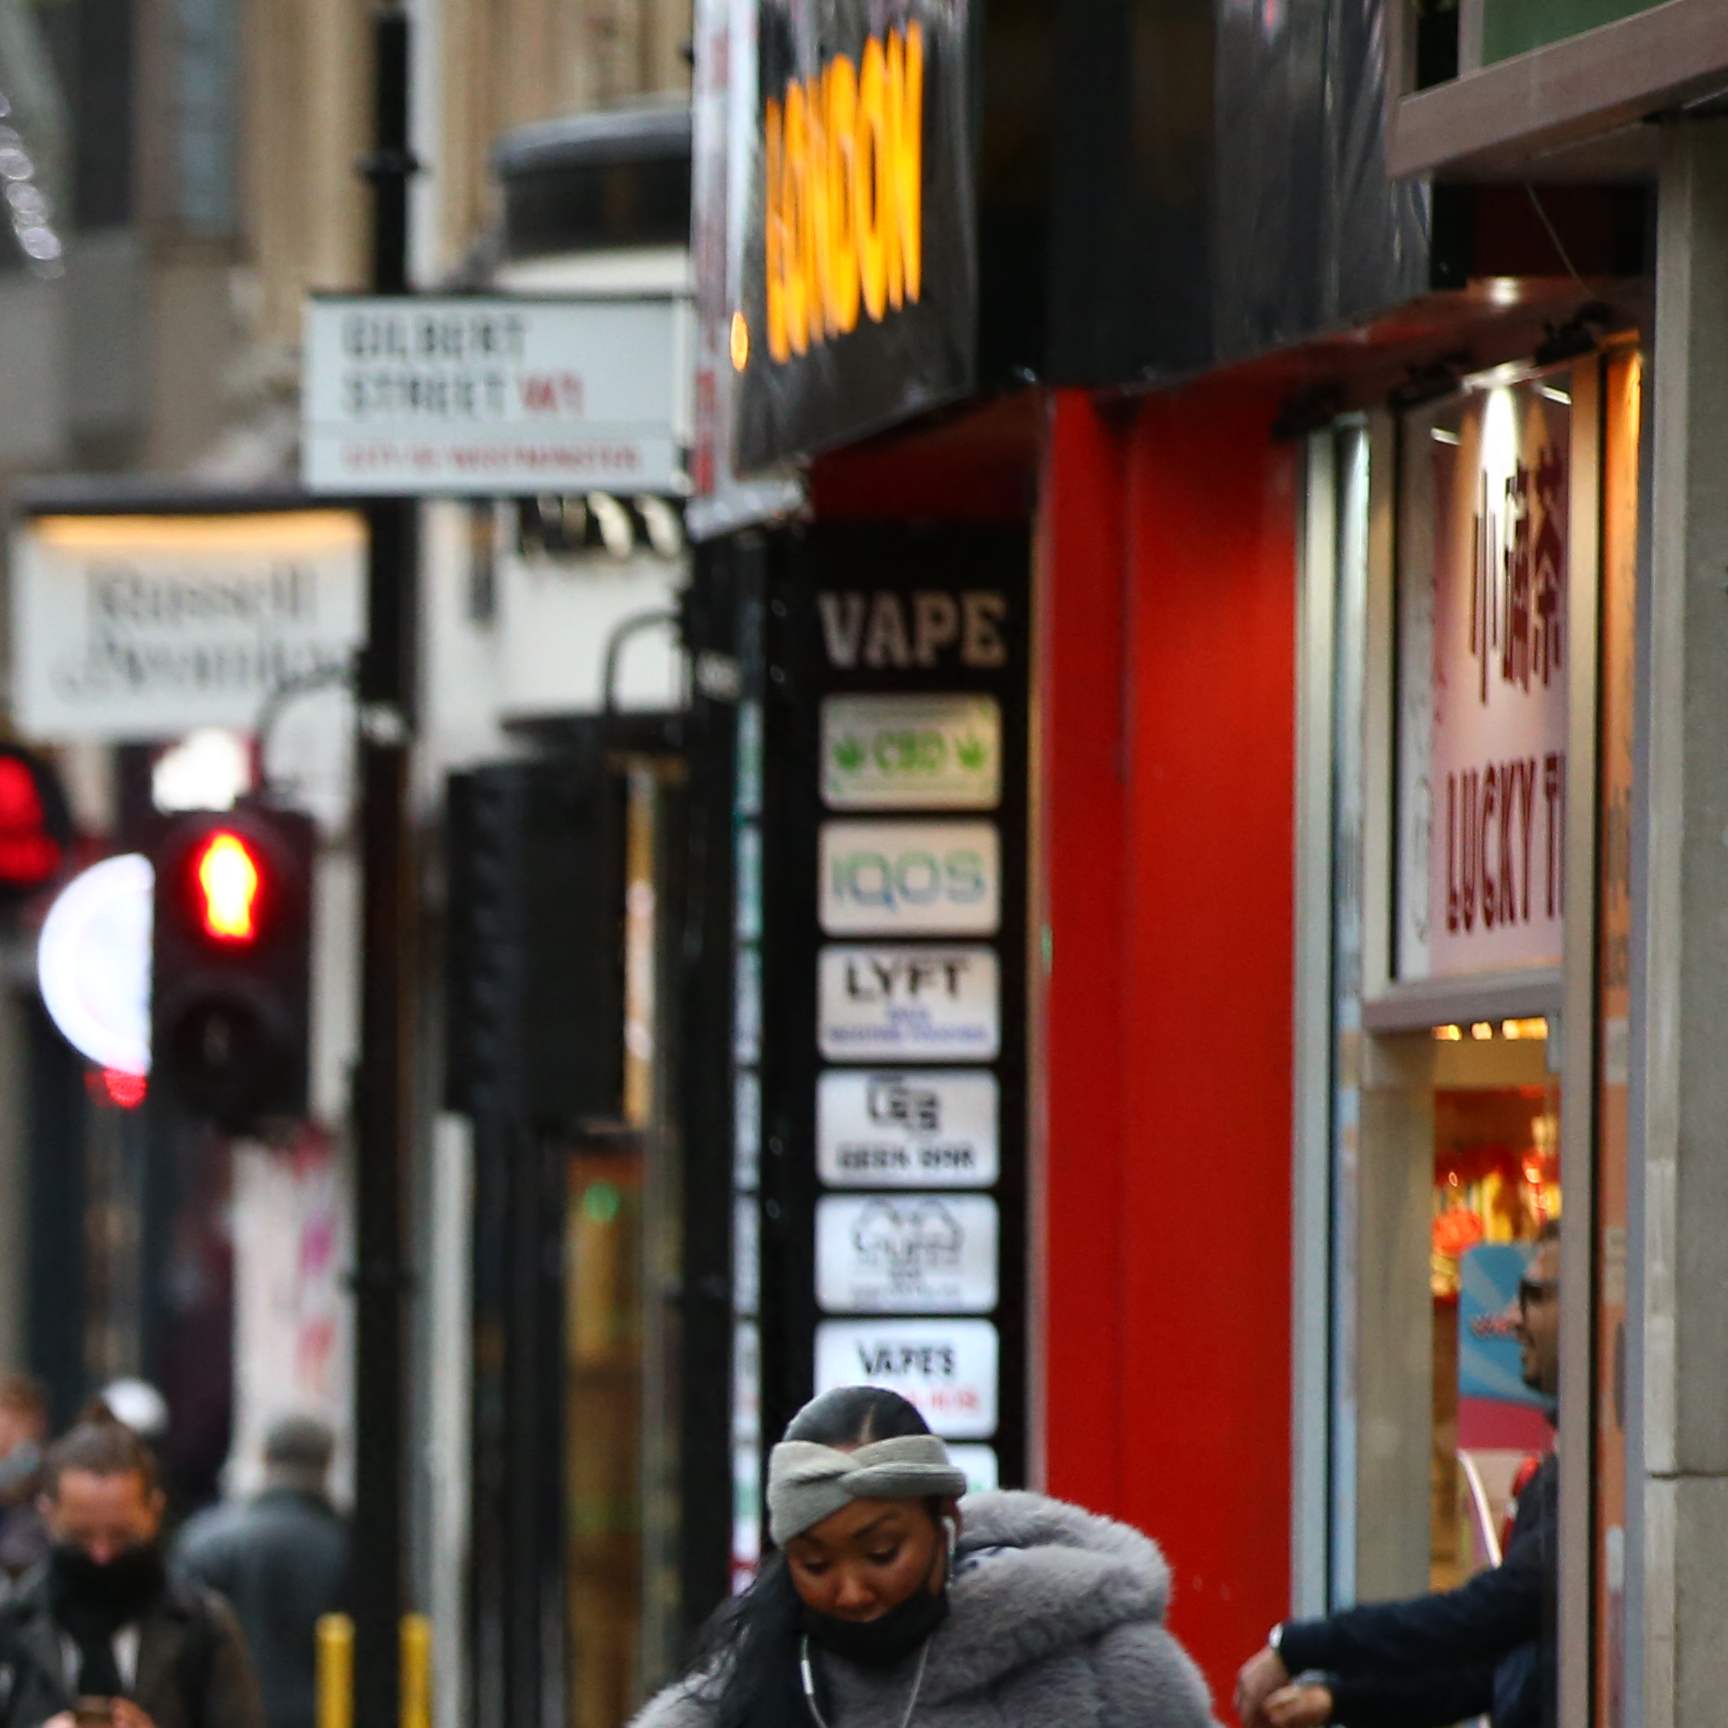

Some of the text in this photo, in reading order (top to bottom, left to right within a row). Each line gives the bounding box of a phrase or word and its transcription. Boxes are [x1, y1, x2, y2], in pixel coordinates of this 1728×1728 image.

[819, 593, 1007, 668] VAPE
[1446, 761, 1537, 933] LUCKY
[832, 850, 985, 911] IQOS
[846, 957, 971, 1001] LYFT
[857, 1339, 957, 1377] VAPES
